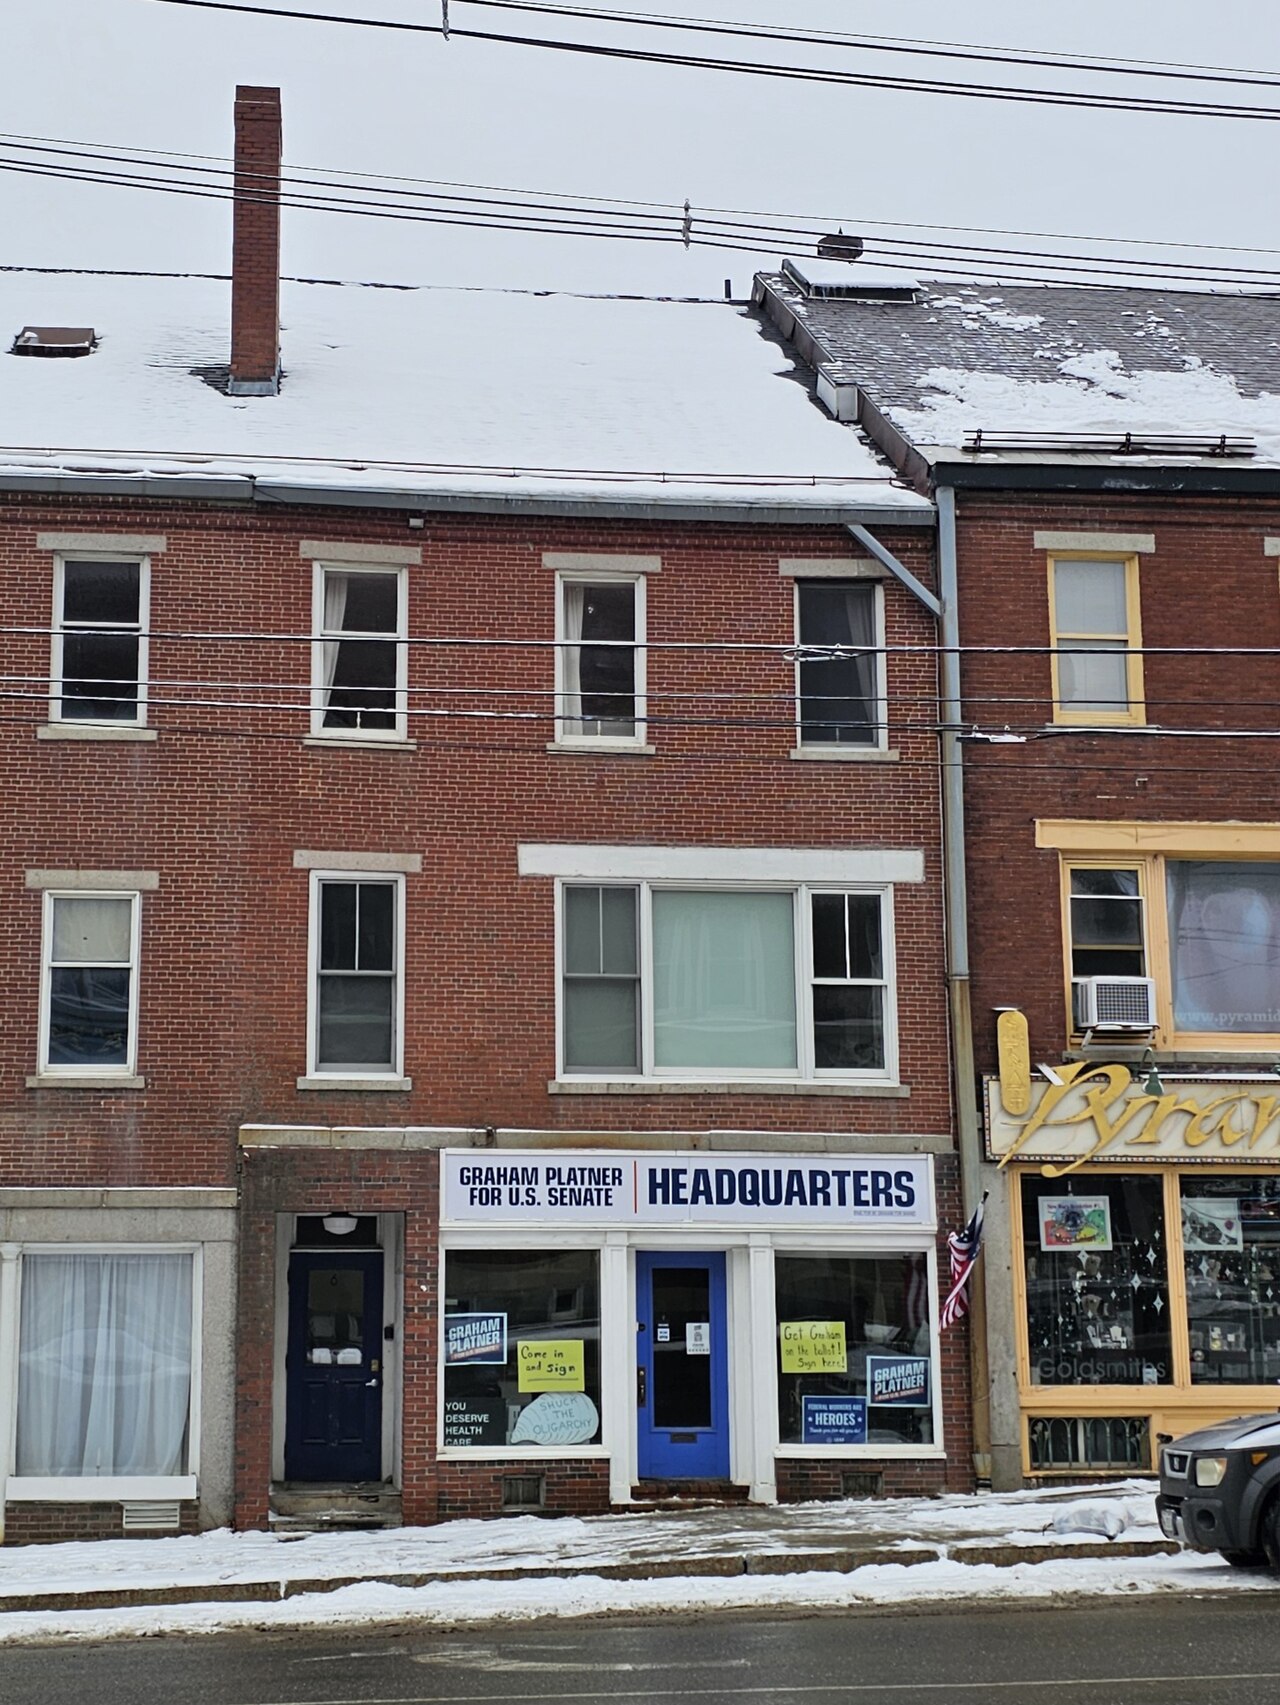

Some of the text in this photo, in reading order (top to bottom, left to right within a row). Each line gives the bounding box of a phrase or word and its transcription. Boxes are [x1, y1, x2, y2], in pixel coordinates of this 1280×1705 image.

[459, 1167, 623, 1187] GRAHAM PLATNER
[648, 1168, 916, 1208] HEADQUARTERS
[469, 1187, 613, 1207] FOR U.S. SENATE
[449, 1317, 500, 1341] GRAHAM
[784, 1325, 803, 1341] Get
[449, 1331, 500, 1355] PLATNER
[797, 1344, 808, 1356] the
[520, 1345, 564, 1359] Come in
[525, 1360, 541, 1371] and
[874, 1361, 924, 1382] GRAHAM
[874, 1374, 924, 1396] PLATNER
[445, 1402, 466, 1411] YOU
[540, 1396, 578, 1411] SHUCK
[445, 1414, 490, 1423] DESERVE
[552, 1408, 575, 1419] THE
[815, 1412, 856, 1426] HEROES
[445, 1426, 483, 1435] HEALTH
[533, 1418, 592, 1435] OLIGARCHY
[445, 1438, 472, 1446] CARE
